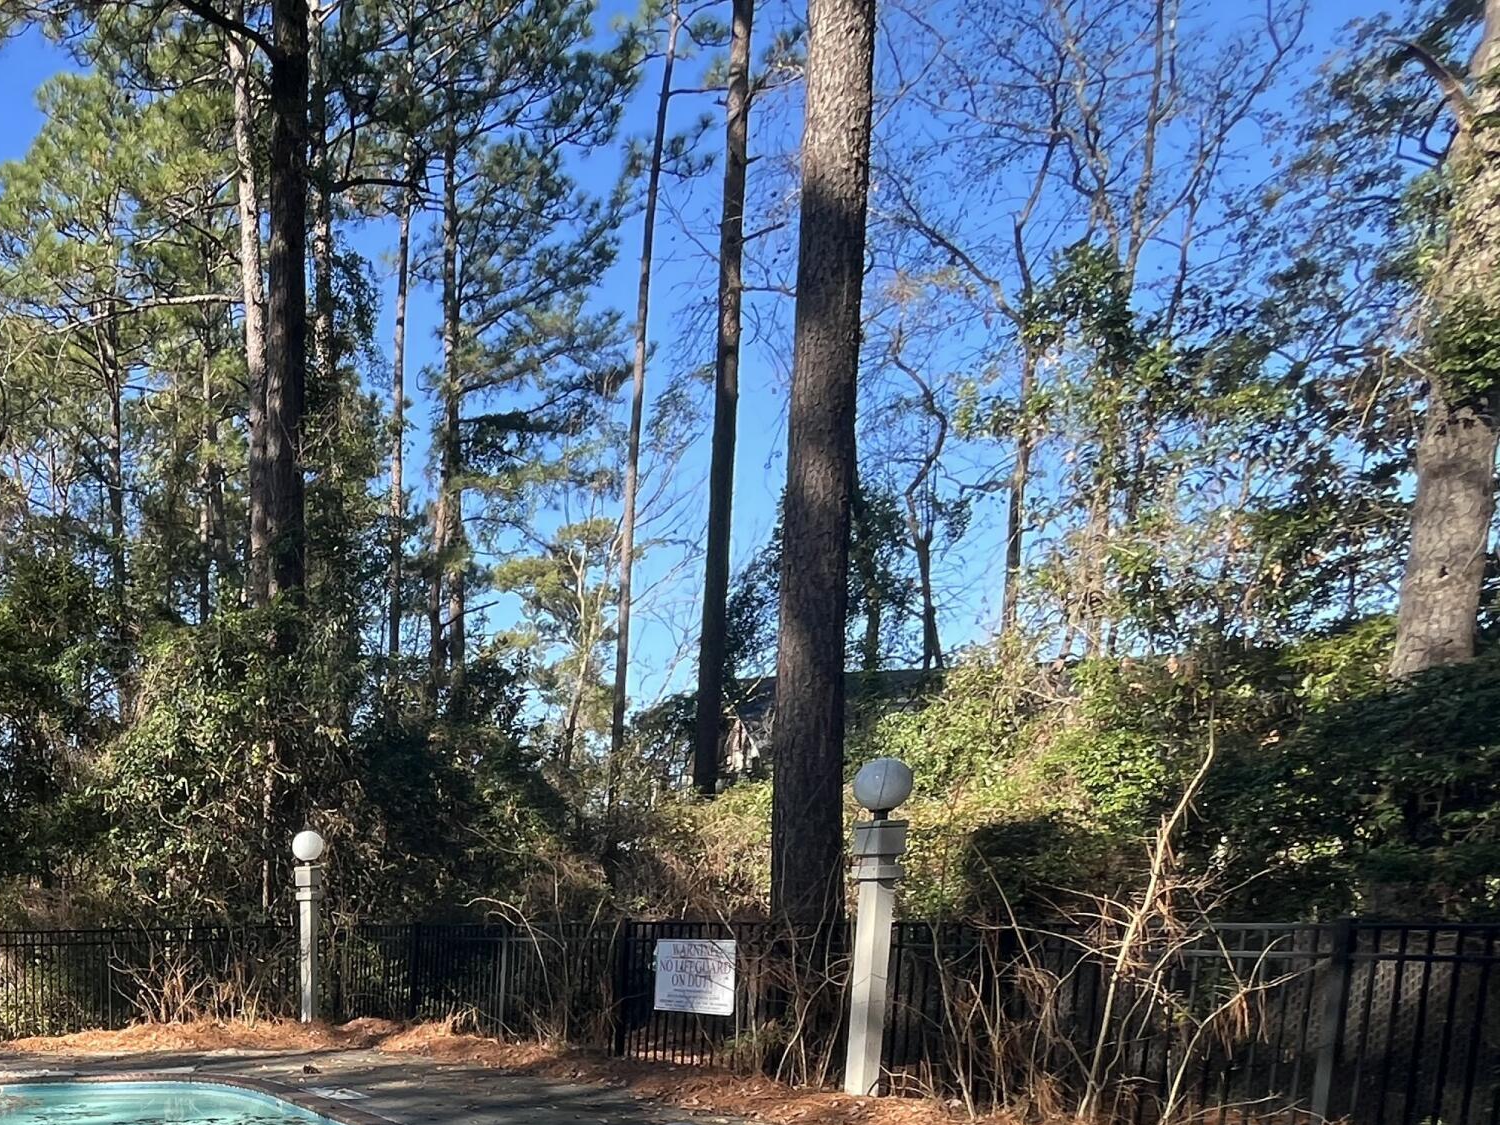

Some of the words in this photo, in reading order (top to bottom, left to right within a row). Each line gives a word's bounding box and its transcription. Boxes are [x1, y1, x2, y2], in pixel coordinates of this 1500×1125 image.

[660, 959, 673, 972] NO
[675, 960, 731, 975] LIFEGUARD
[671, 973, 685, 986] ON
